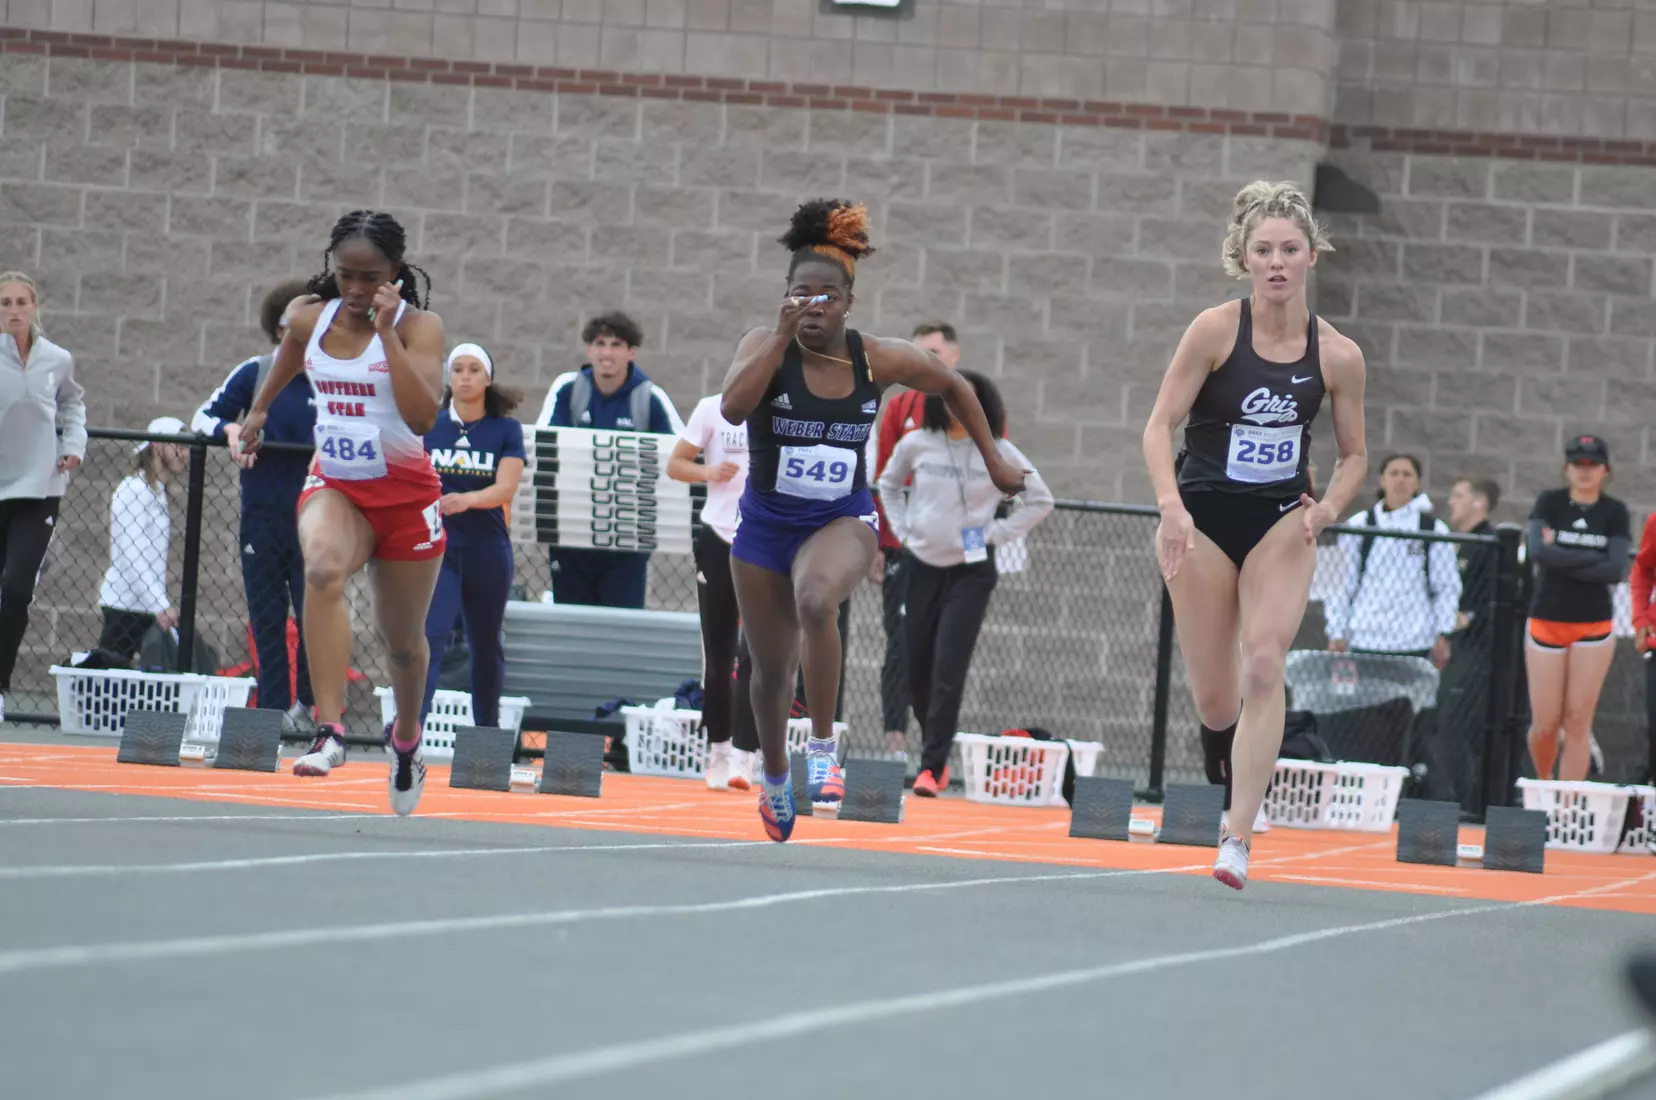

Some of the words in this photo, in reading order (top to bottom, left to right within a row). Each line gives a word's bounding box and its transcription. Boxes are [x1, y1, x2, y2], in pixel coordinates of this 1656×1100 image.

[327, 400, 366, 416] UTAH
[1241, 387, 1298, 423] Griz
[772, 415, 825, 438] WEBER
[592, 434, 658, 451] UCS
[720, 431, 746, 447] TRAC
[321, 436, 377, 461] 484
[593, 449, 659, 465] UCS
[1236, 440, 1294, 465] 258
[431, 448, 495, 471] NAU
[595, 463, 660, 480] UCS
[785, 457, 849, 483] 549
[590, 477, 656, 494] UCS
[592, 492, 657, 507] UCS
[592, 505, 657, 523] UCS
[591, 520, 656, 536] UCS
[592, 534, 657, 549] UCS
